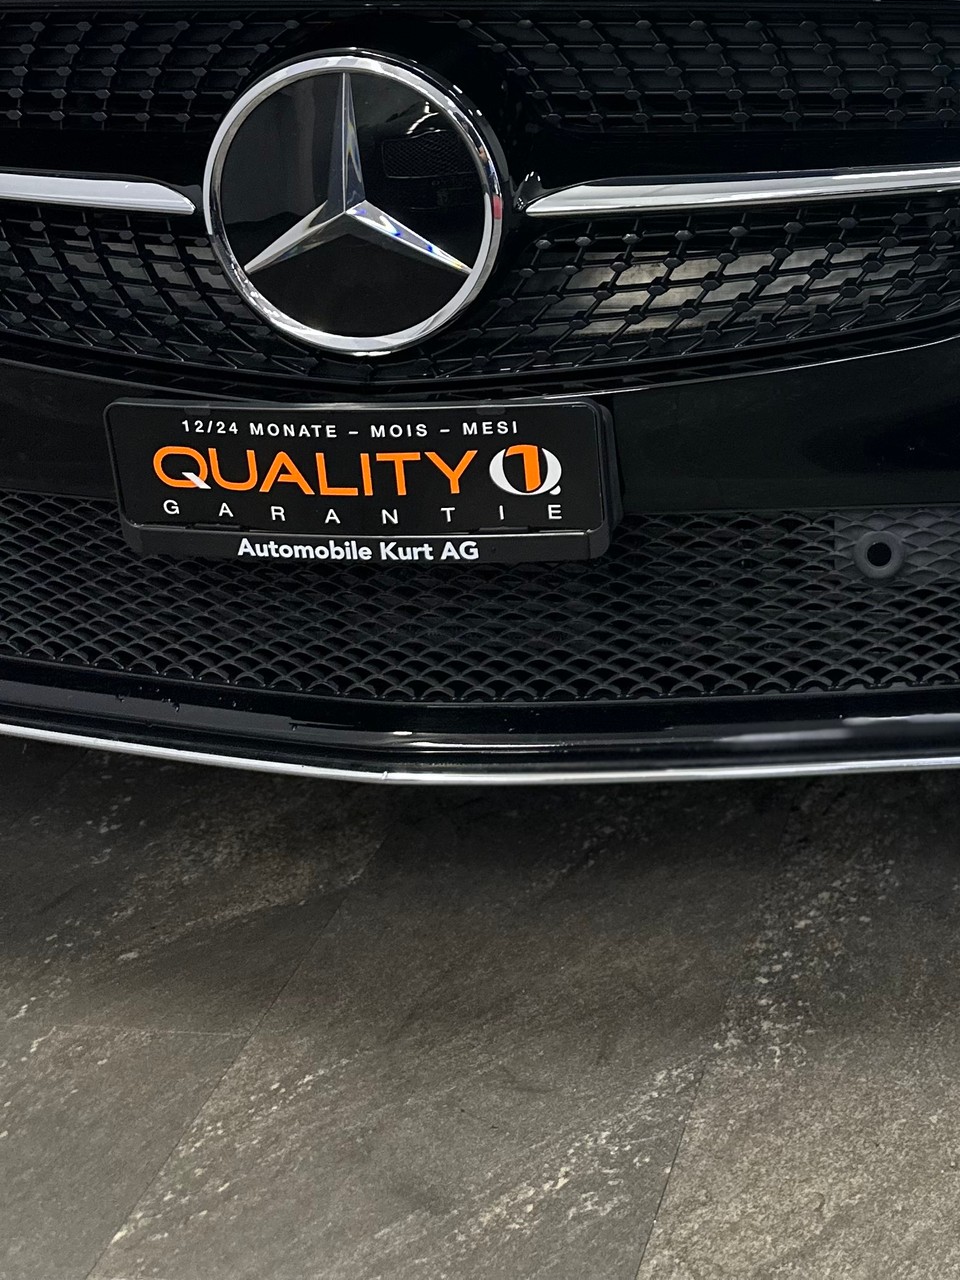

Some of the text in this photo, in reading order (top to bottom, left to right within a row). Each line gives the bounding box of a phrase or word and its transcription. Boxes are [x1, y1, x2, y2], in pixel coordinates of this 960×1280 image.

[181, 419, 239, 435] 12/24
[250, 422, 337, 438] MONATE
[370, 424, 428, 438] MOIS
[462, 421, 518, 436] MESI
[152, 445, 478, 497] QUALITY
[163, 499, 563, 525] GARANTIE
[237, 538, 479, 561] Automobile Kurt AG
